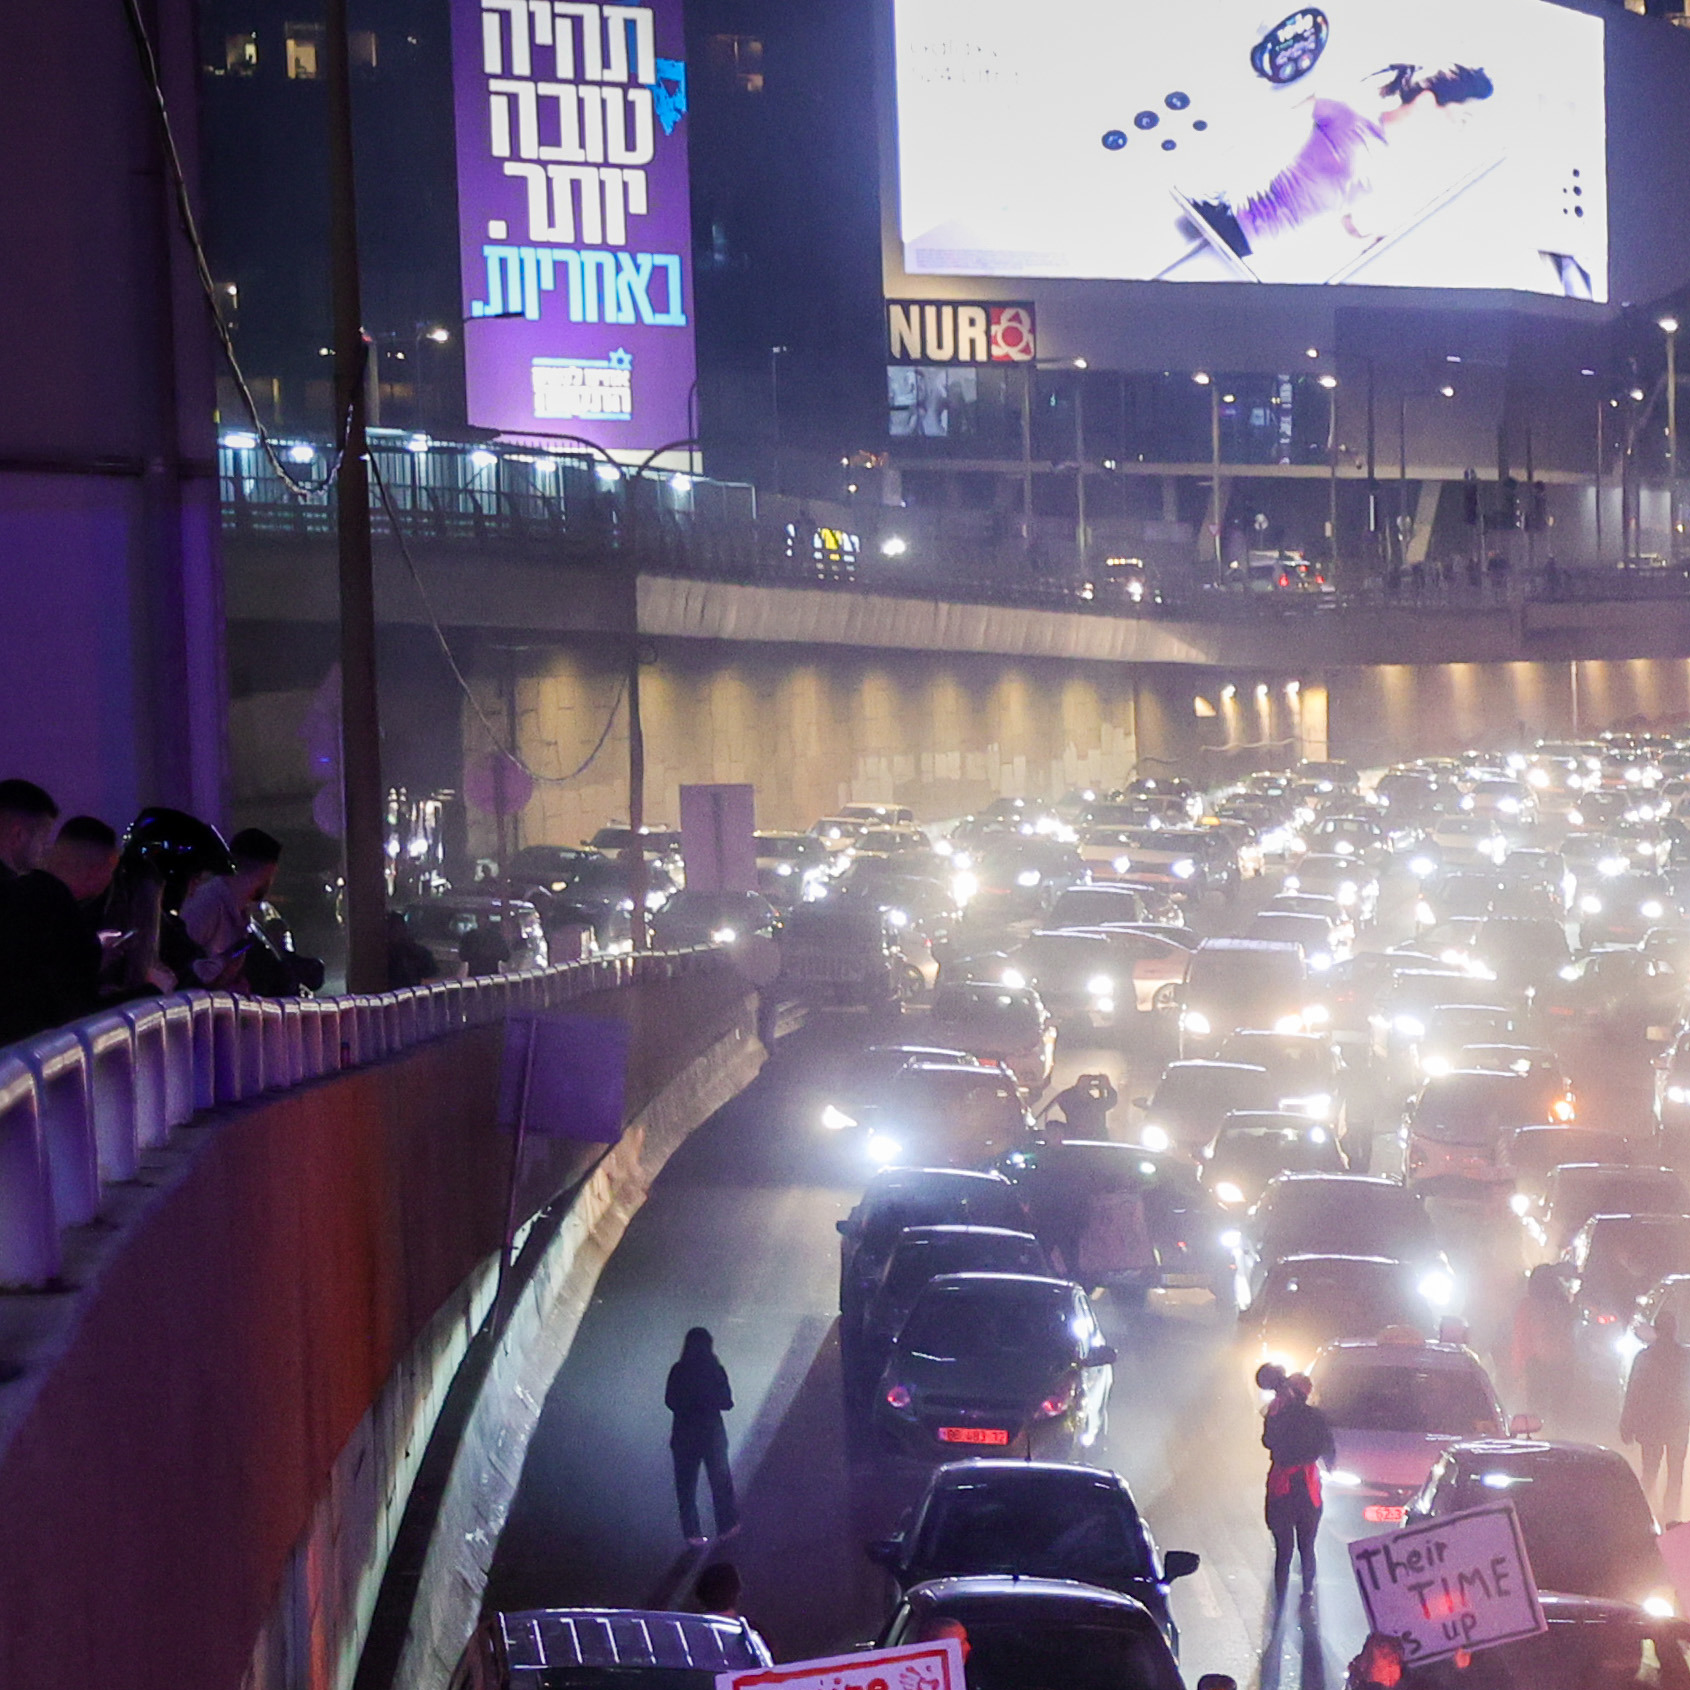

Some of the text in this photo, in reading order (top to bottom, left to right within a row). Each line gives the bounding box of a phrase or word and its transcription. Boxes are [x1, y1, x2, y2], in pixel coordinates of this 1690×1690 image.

[480, 0, 656, 84] תהיה
[489, 79, 655, 165] טובה
[488, 161, 648, 245] יותר.
[471, 245, 687, 326] באחריות.
[889, 304, 988, 362] NUR
[1355, 1540, 1448, 1591] Their
[1407, 1557, 1511, 1620] TIME
[1442, 1612, 1478, 1643] up
